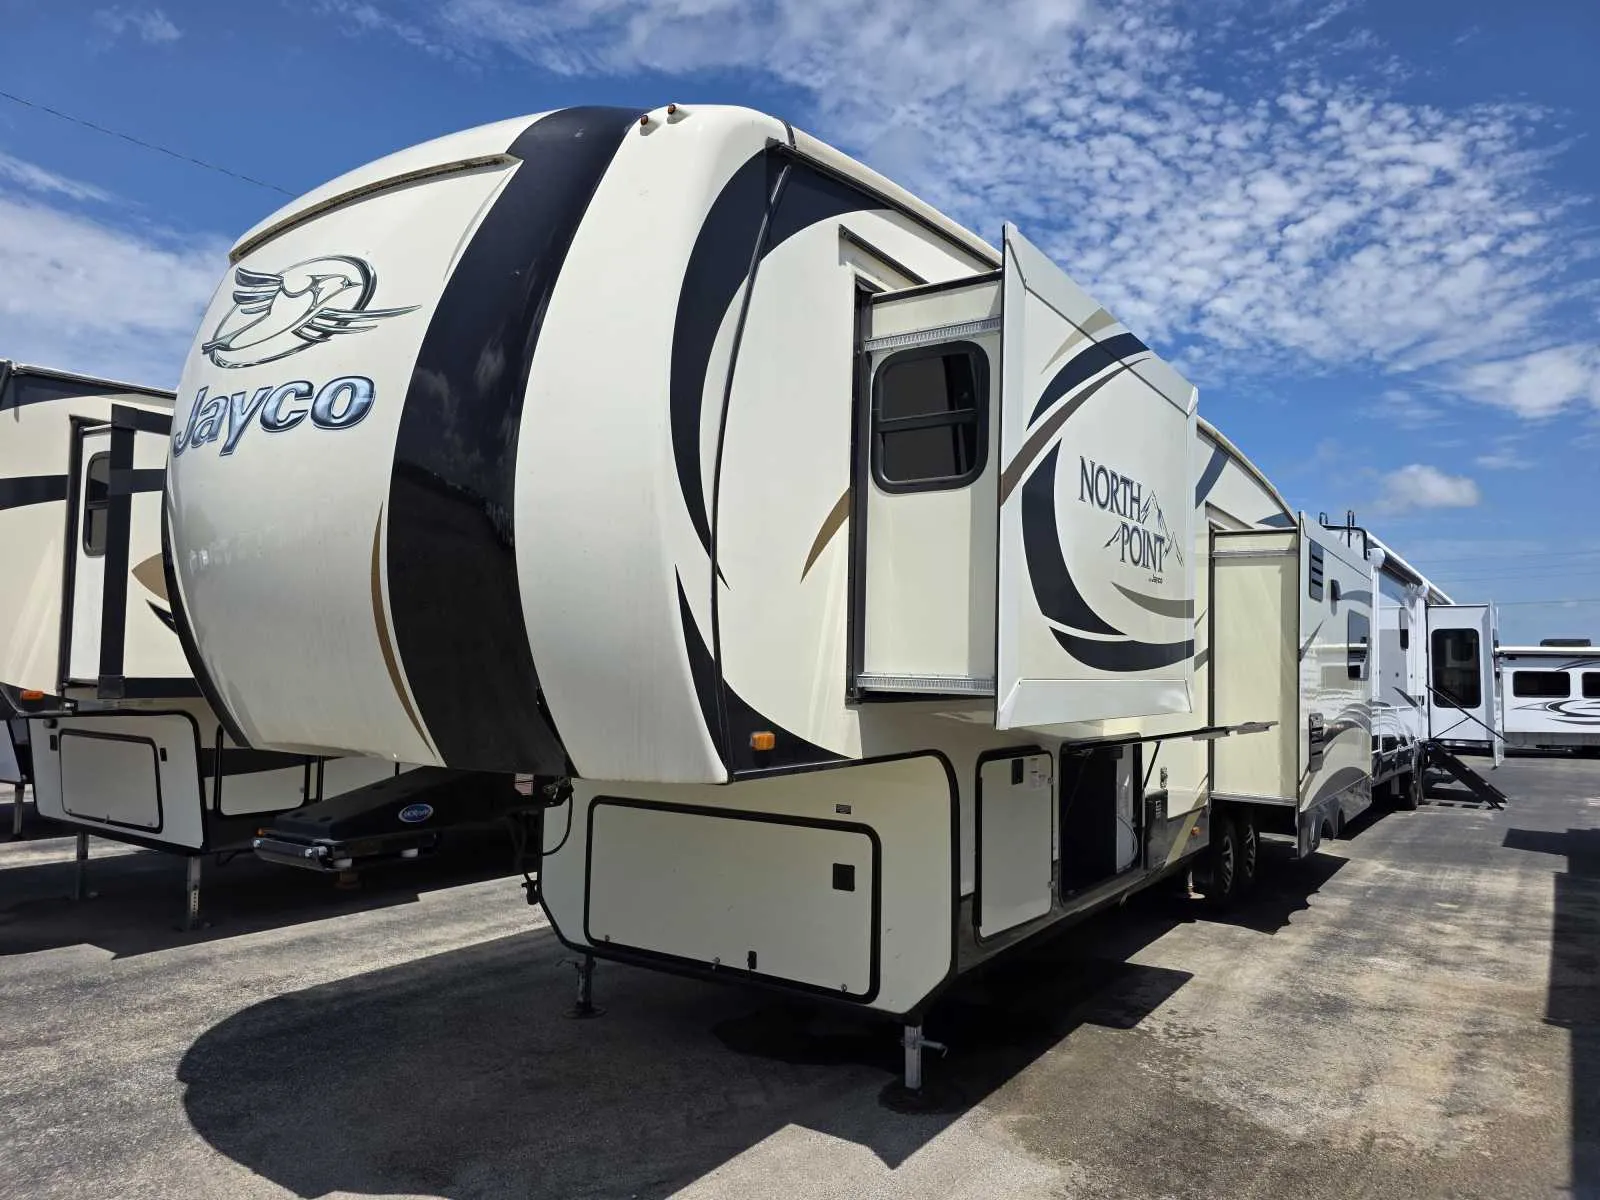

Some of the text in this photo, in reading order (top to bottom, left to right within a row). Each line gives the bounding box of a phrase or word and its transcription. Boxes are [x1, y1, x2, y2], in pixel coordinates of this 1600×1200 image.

[173, 375, 375, 457] Jayco
[1079, 455, 1142, 523] NORTH
[1120, 521, 1165, 572] POINT
